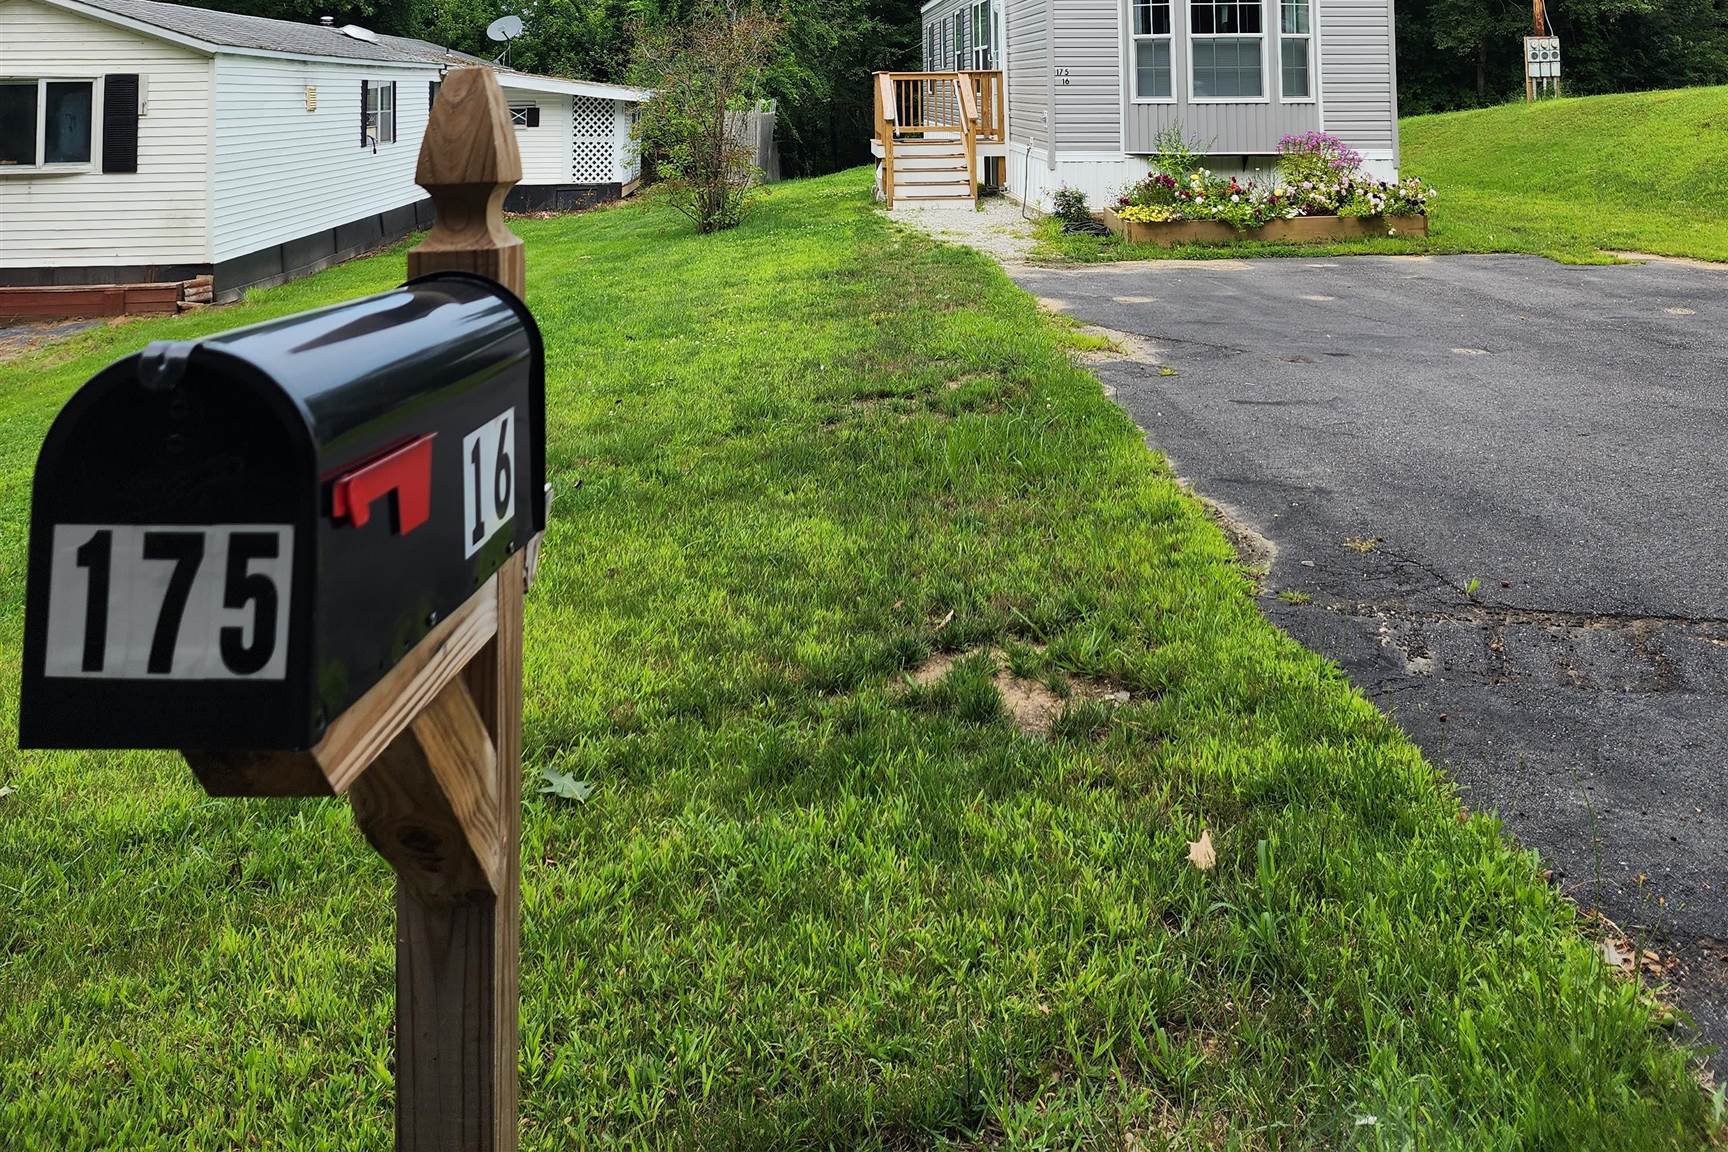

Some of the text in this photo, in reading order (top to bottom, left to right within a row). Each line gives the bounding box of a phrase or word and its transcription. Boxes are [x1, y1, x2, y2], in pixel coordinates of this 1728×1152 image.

[1056, 68, 1070, 76] 175
[471, 418, 511, 546] 16
[76, 530, 279, 675] 175
